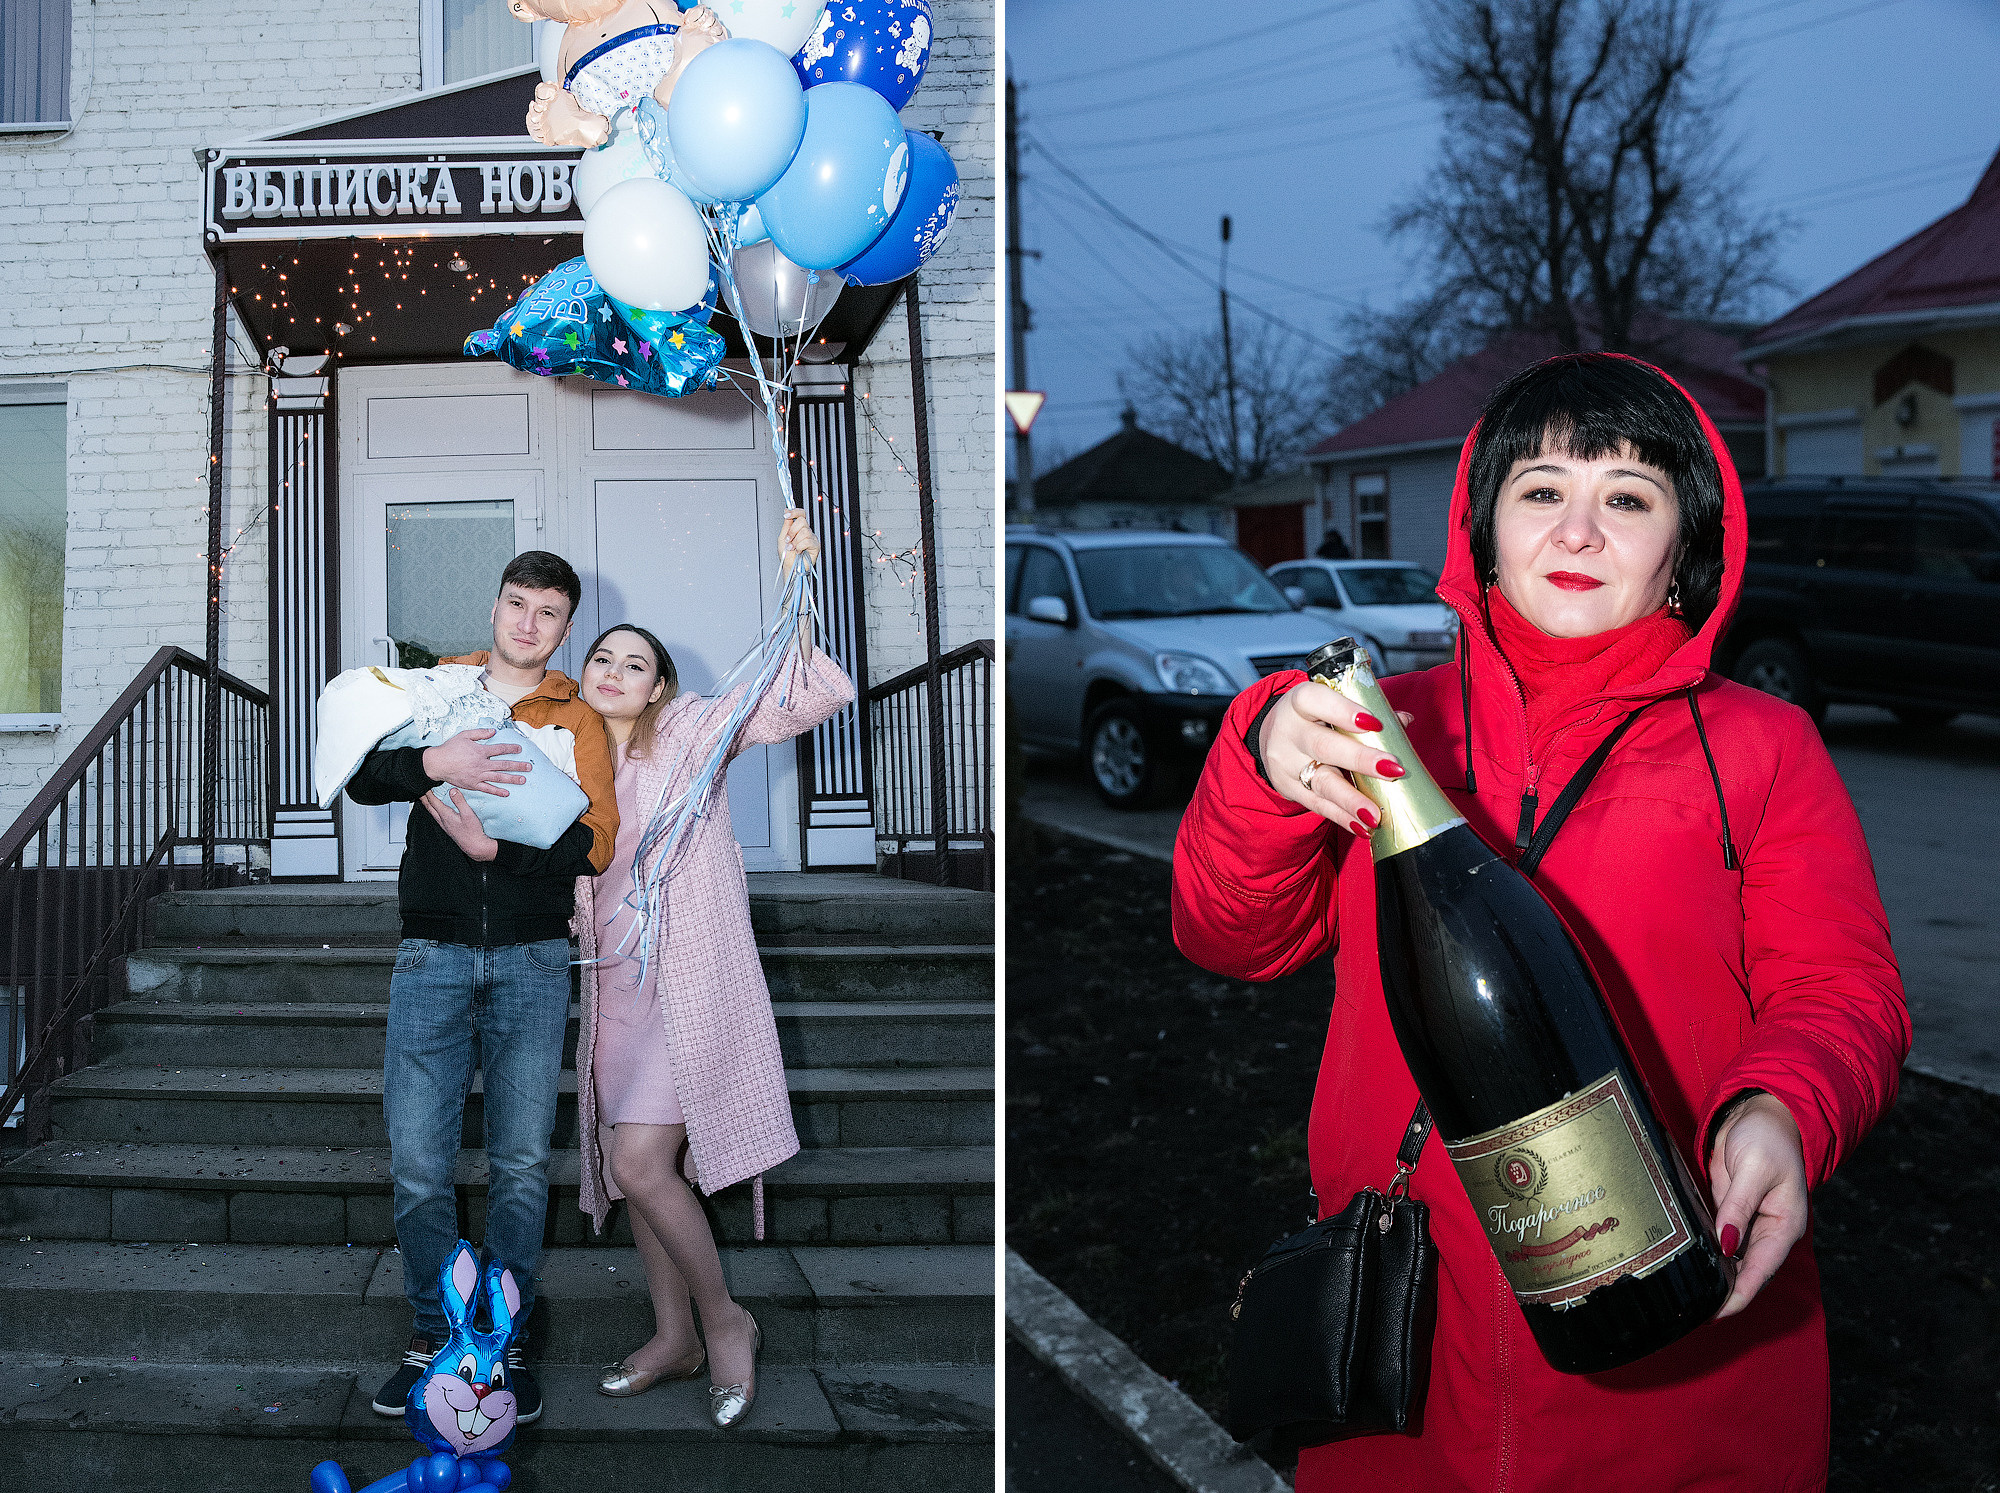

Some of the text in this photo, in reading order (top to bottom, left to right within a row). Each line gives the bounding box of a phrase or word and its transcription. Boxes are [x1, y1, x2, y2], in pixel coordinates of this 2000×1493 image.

[222, 161, 578, 218] ВЫПИСКА НОВ
[525, 276, 567, 320] It's
[551, 275, 595, 324] Bo
[1487, 1186, 1606, 1242] Подарочное
[1644, 1224, 1663, 1243] 11%
